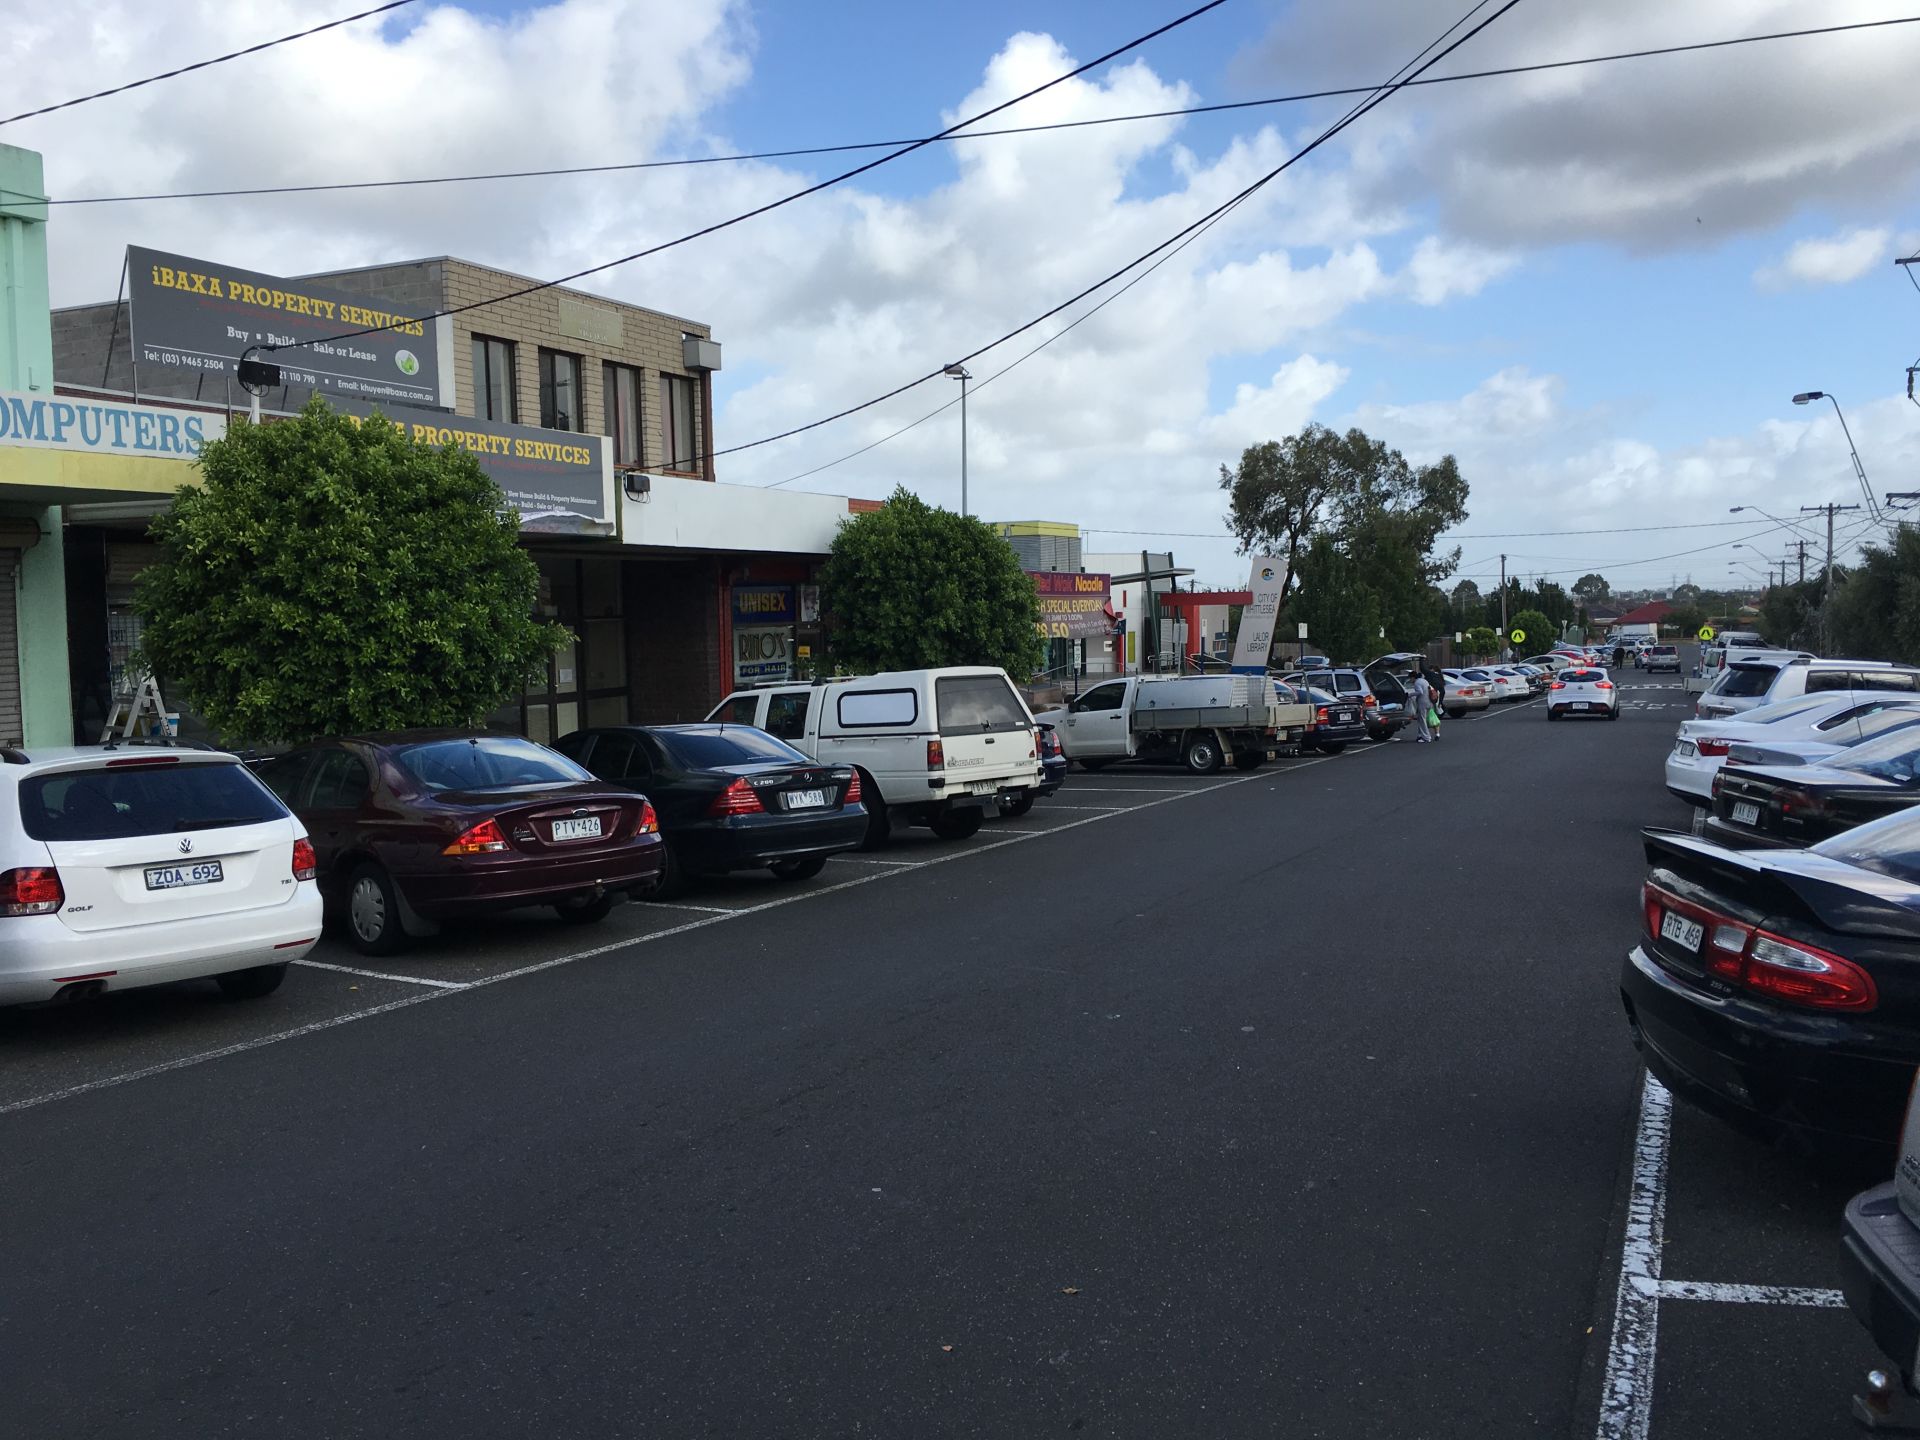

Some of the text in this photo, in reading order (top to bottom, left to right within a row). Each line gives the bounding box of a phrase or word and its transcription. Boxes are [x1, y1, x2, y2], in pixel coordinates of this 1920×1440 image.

[151, 265, 223, 298] iBAXA
[228, 280, 335, 320] PROPERTY
[340, 303, 425, 337] SERVICES
[226, 325, 377, 362] Buy Build Sale or Lease
[144, 350, 160, 362] Tel:
[162, 352, 180, 367] (03)
[182, 356, 202, 367] 9465
[203, 359, 224, 371] 2504
[287, 371, 301, 383] 110
[302, 373, 316, 385] 790
[337, 379, 359, 391] Email:
[412, 423, 511, 456] PROPERTY
[515, 438, 591, 466] SERVICES
[1075, 575, 1103, 592] Noodle
[740, 592, 786, 612] UNISEX
[1257, 592, 1278, 603] CITY OF
[1047, 599, 1072, 614] SPECIAL
[1072, 599, 1104, 613] EVERYDAY
[1246, 642, 1268, 653] LIBRARY
[742, 664, 786, 675] FOR HAIR
[67, 905, 94, 913] GOLF
